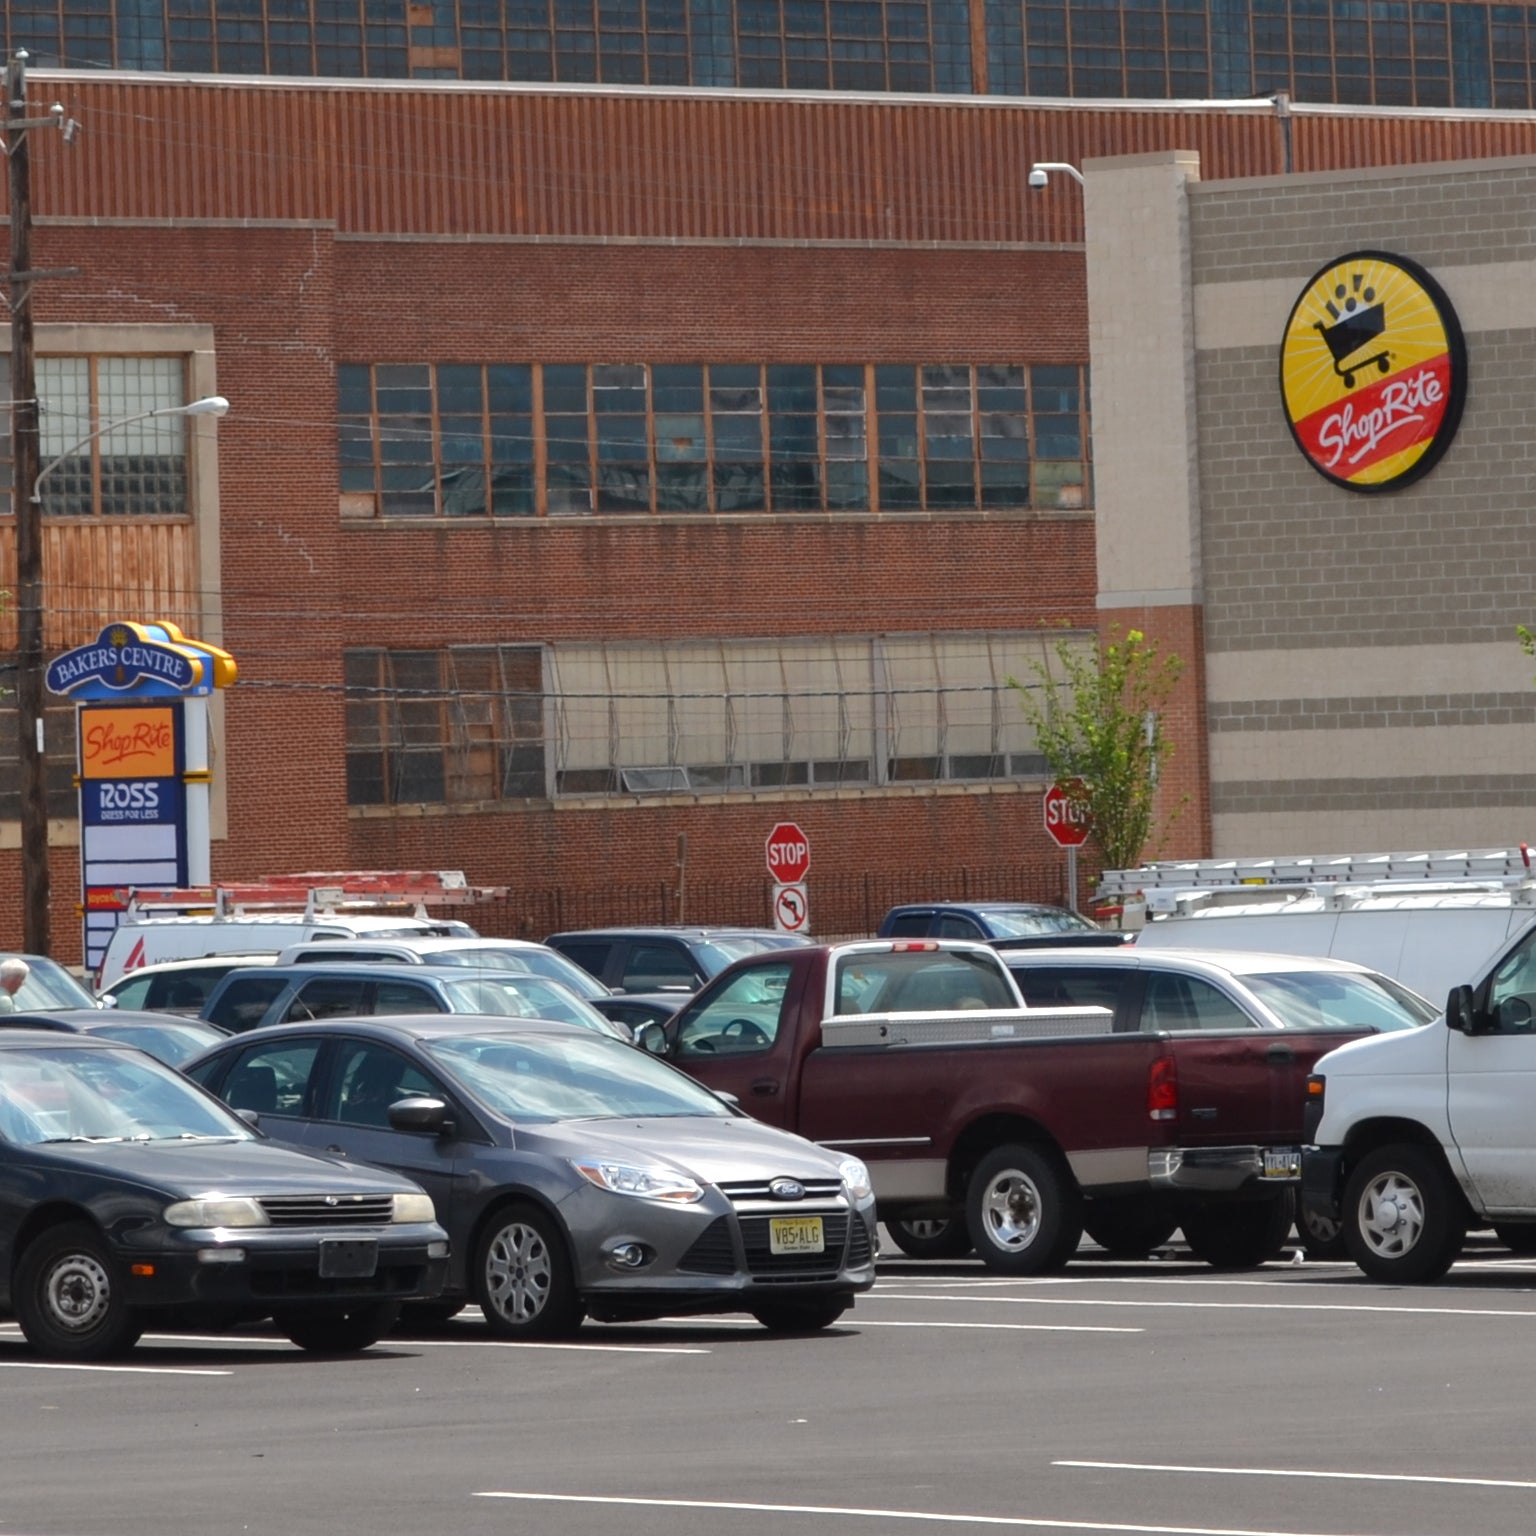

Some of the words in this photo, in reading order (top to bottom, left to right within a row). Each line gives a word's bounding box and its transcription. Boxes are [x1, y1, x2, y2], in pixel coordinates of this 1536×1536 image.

[1319, 370, 1443, 467] ShopRite
[56, 647, 117, 684] BAKERS
[121, 647, 184, 679] CENTRE
[85, 722, 170, 762] ShopRite
[100, 782, 159, 808] ROSS
[101, 810, 124, 820] DRESS
[125, 810, 140, 819] FOR
[141, 809, 159, 819] LESS
[770, 843, 805, 865] STOP
